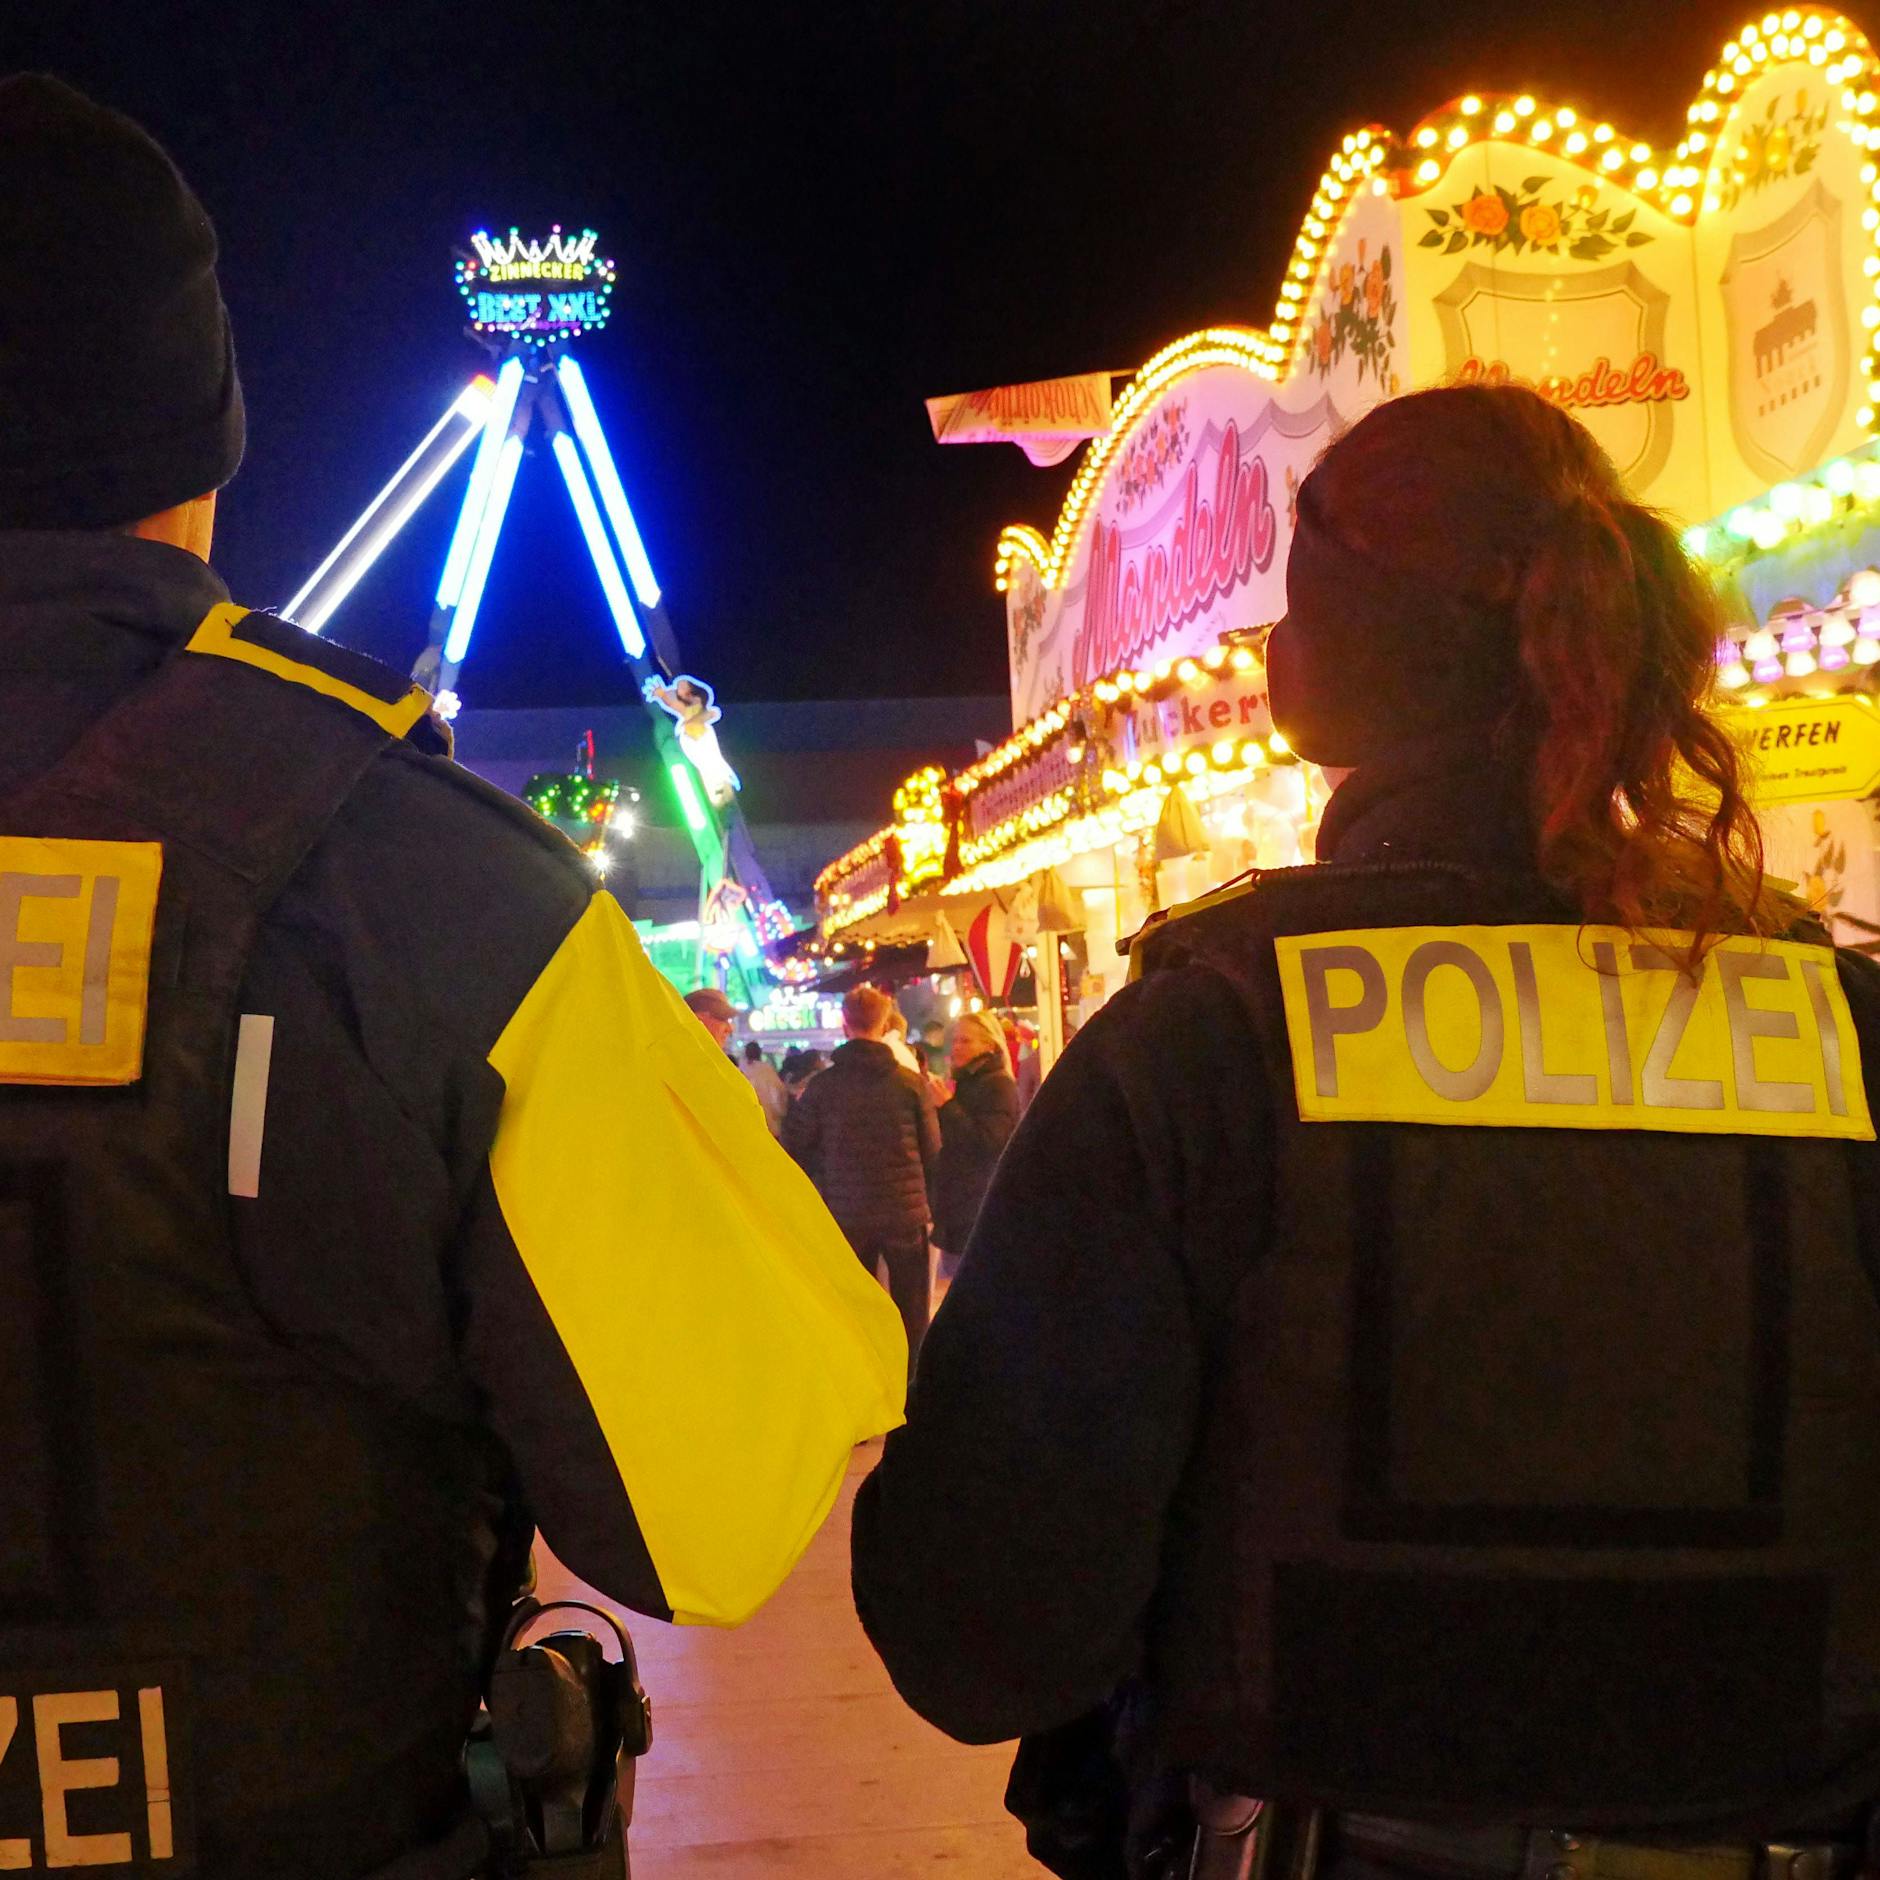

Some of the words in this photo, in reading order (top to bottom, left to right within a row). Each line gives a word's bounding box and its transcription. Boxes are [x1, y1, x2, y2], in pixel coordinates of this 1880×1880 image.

[489, 261, 584, 282] ZINNECKER
[547, 291, 602, 322] XXL
[1460, 353, 1690, 408] ndeln
[1071, 416, 1277, 694] Mandeln
[1299, 940, 1849, 1117] POLIZEI
